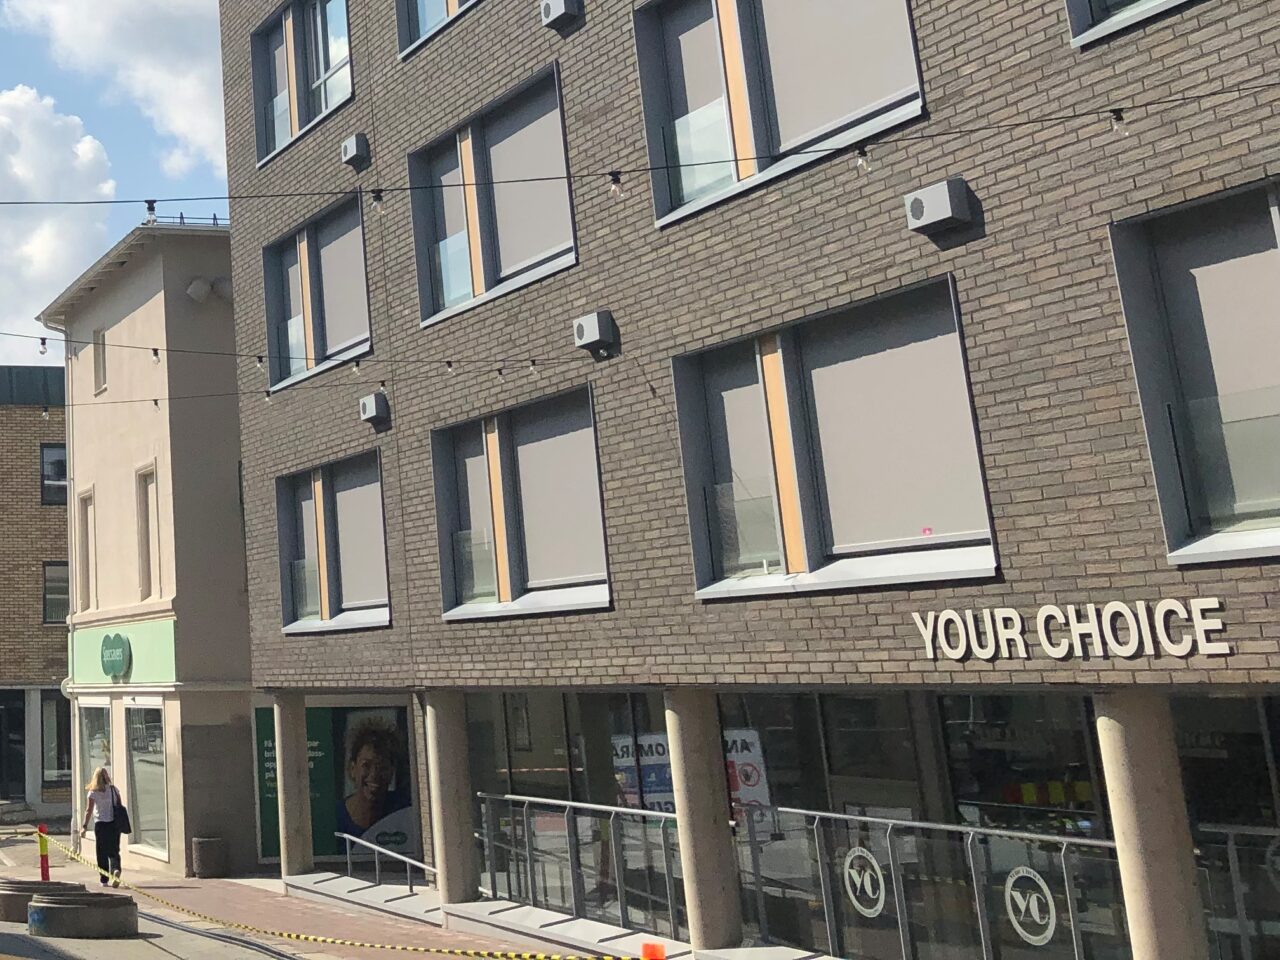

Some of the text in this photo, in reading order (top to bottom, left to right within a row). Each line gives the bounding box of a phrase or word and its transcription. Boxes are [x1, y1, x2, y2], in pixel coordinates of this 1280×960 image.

[911, 597, 1231, 659] YOUR CHOICE
[848, 869, 880, 899] YC
[1010, 891, 1049, 924] YC
